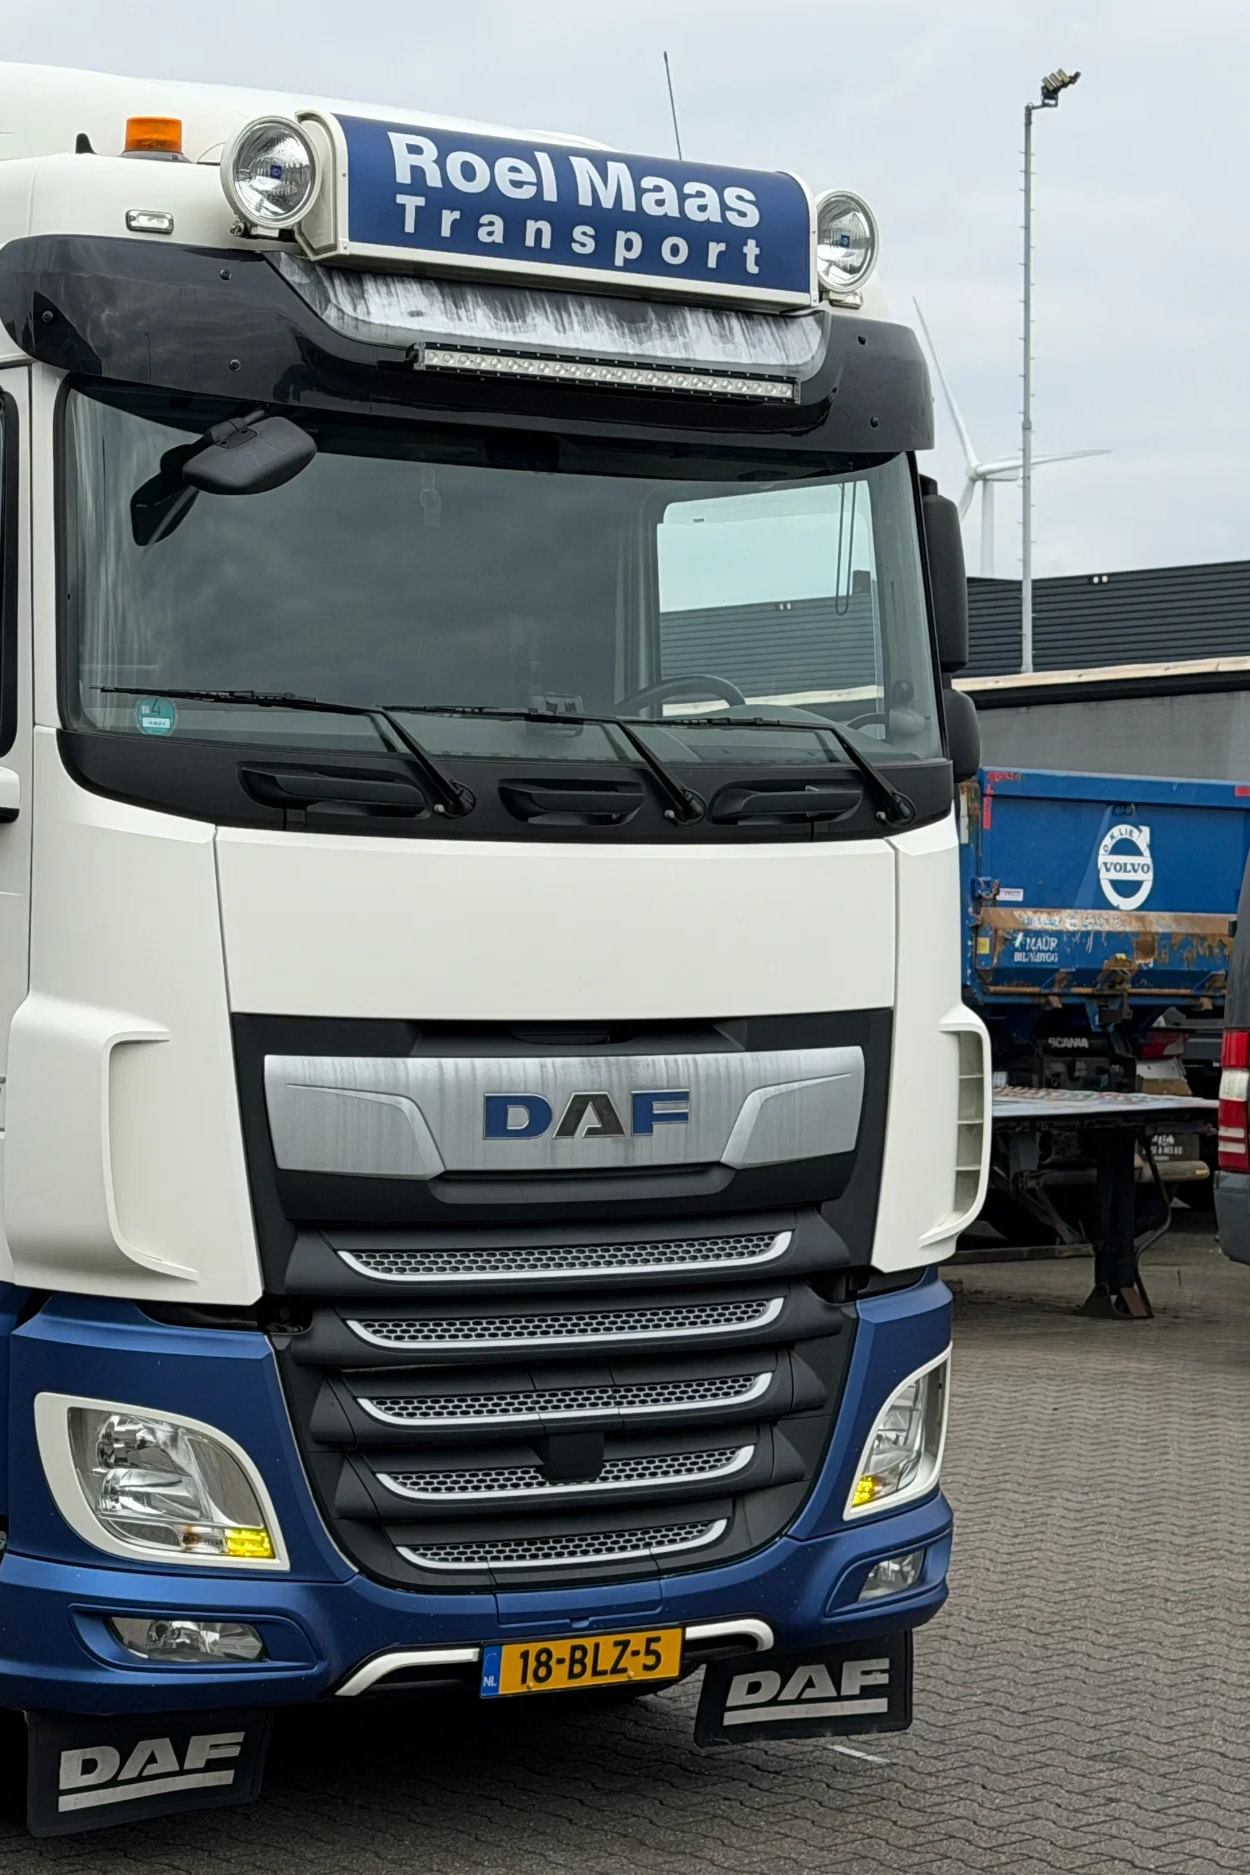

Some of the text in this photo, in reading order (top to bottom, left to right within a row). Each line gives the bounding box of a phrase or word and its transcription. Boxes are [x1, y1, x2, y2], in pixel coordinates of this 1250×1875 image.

[387, 131, 761, 229] Roel Maas
[395, 193, 761, 275] Transport
[1102, 861, 1151, 874] VOLVO
[1047, 1036, 1089, 1049] SCANIA
[482, 1088, 691, 1141] DAF
[482, 1635, 663, 1688] NL 18-BLZ-5
[725, 1657, 891, 1708] DAF
[58, 1731, 246, 1791] DAF
